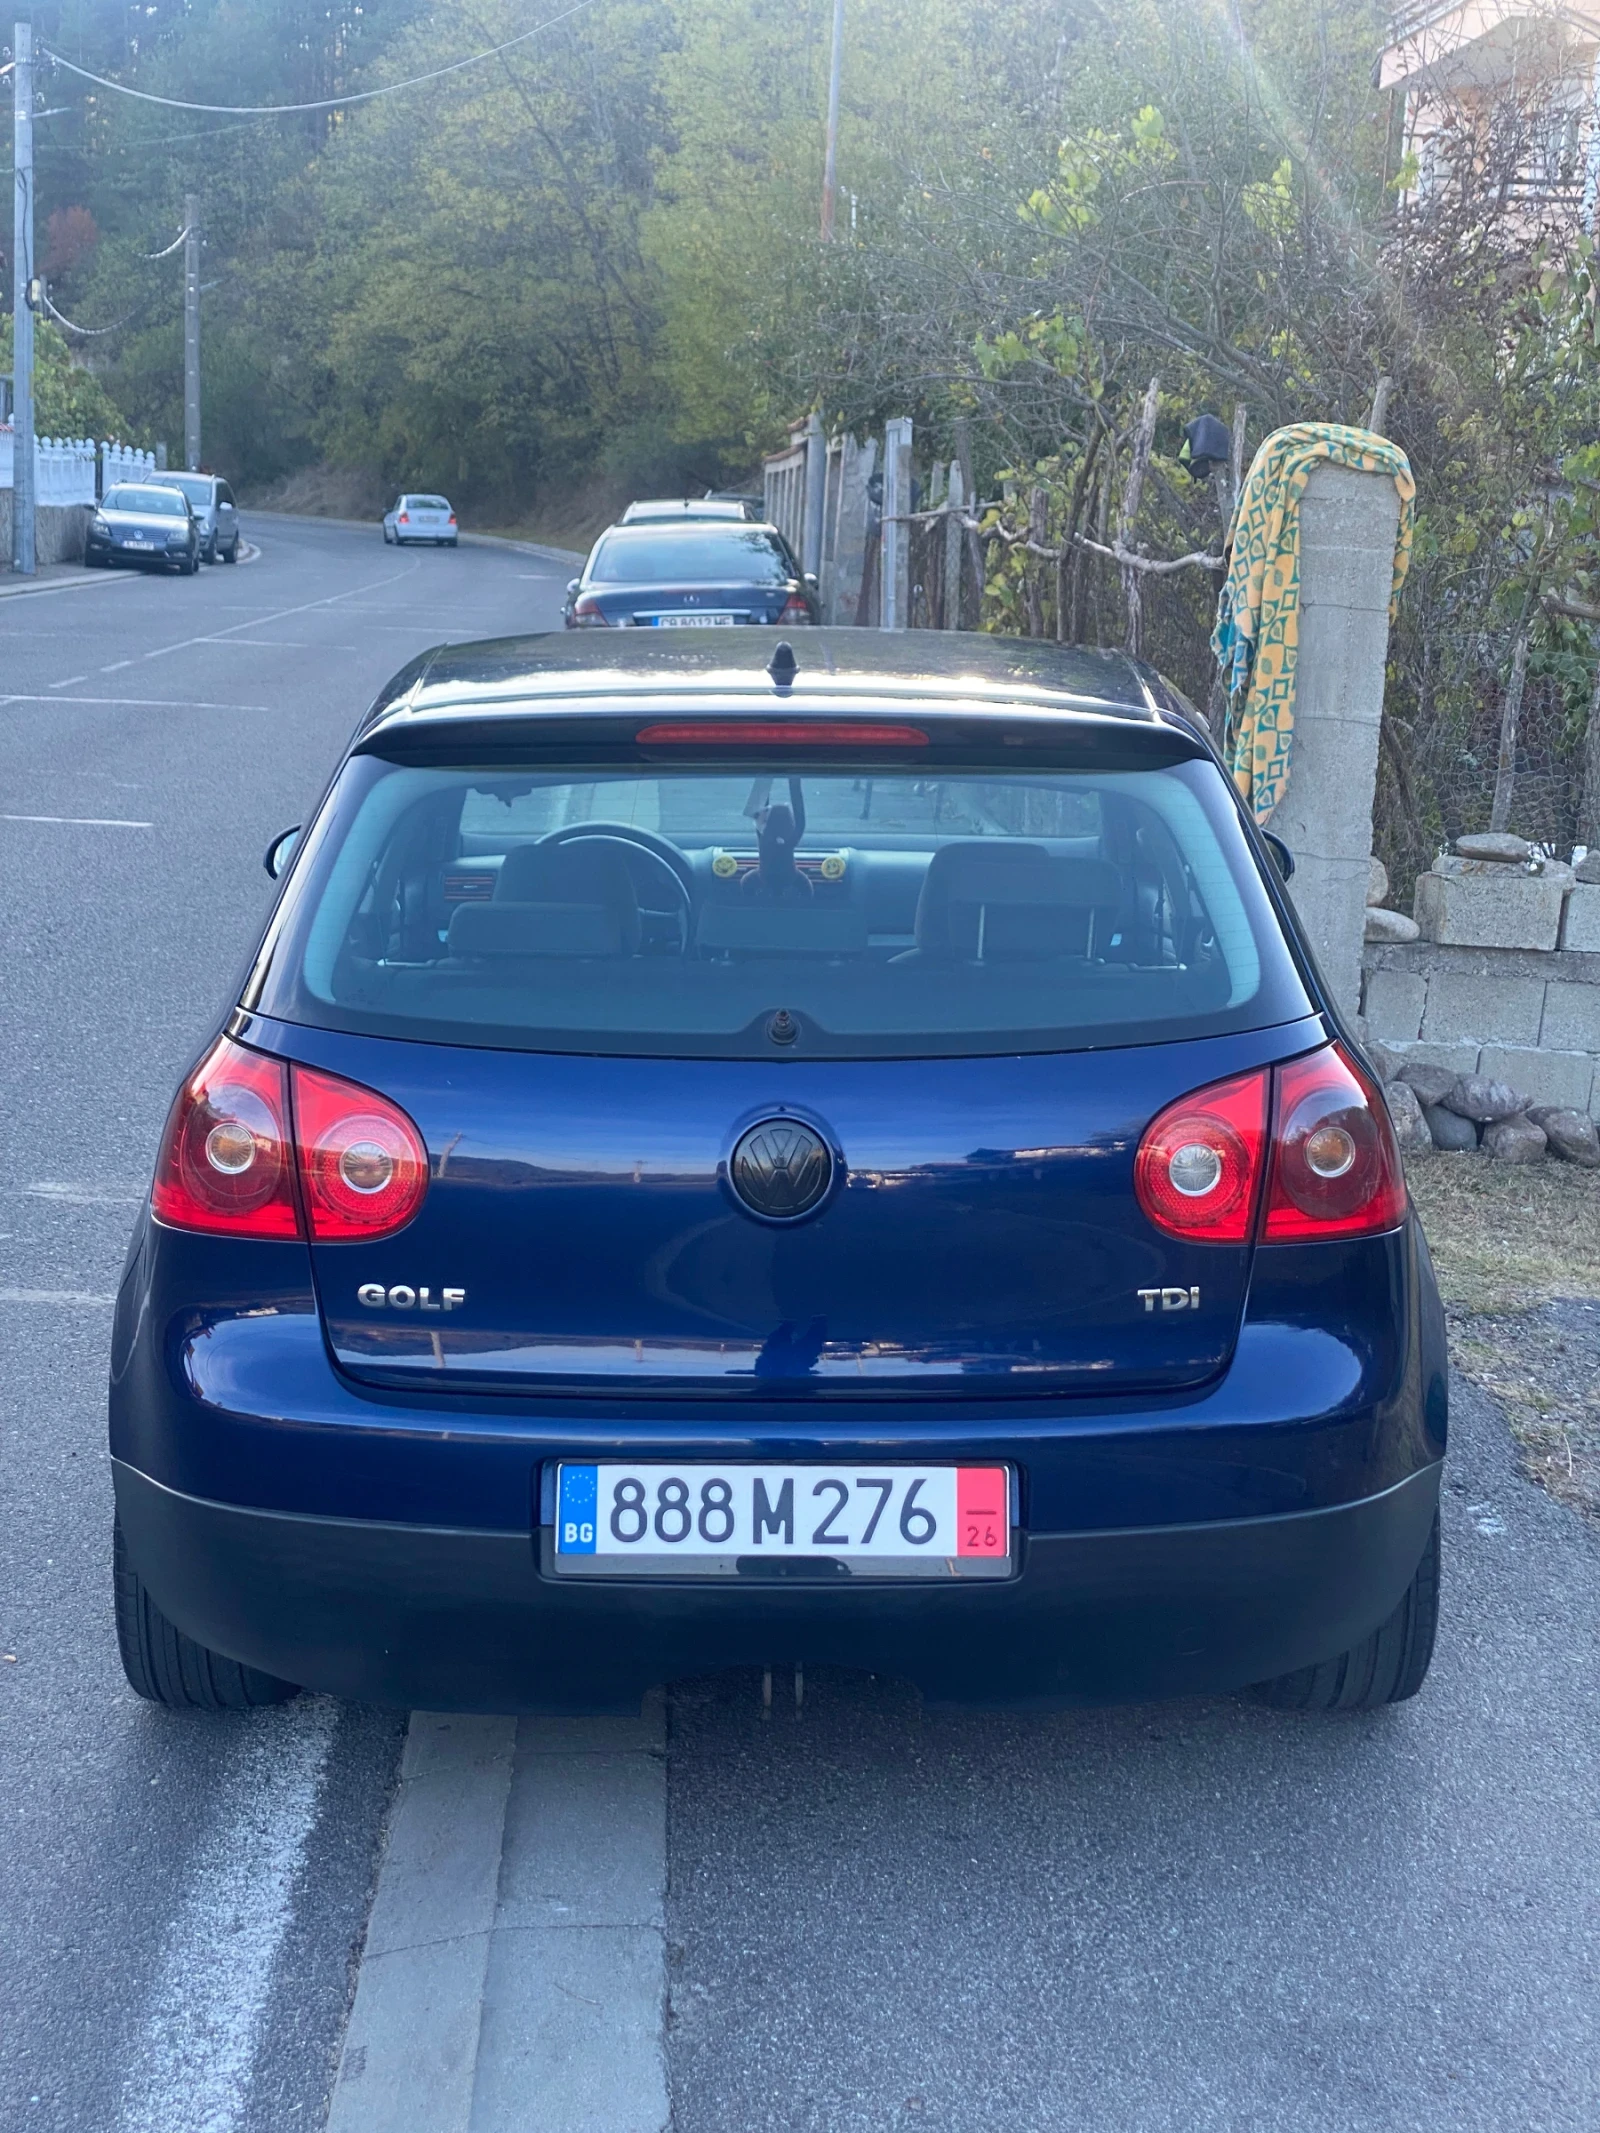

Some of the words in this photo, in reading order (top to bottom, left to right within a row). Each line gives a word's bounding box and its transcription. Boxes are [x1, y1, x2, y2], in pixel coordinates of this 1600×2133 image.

[357, 1284, 466, 1310] GOLF
[1137, 1286, 1200, 1311] TDI
[610, 1477, 735, 1543] 888
[752, 1477, 794, 1544] M
[812, 1478, 937, 1545] 276
[565, 1522, 593, 1543] BG
[966, 1526, 997, 1547] 26
